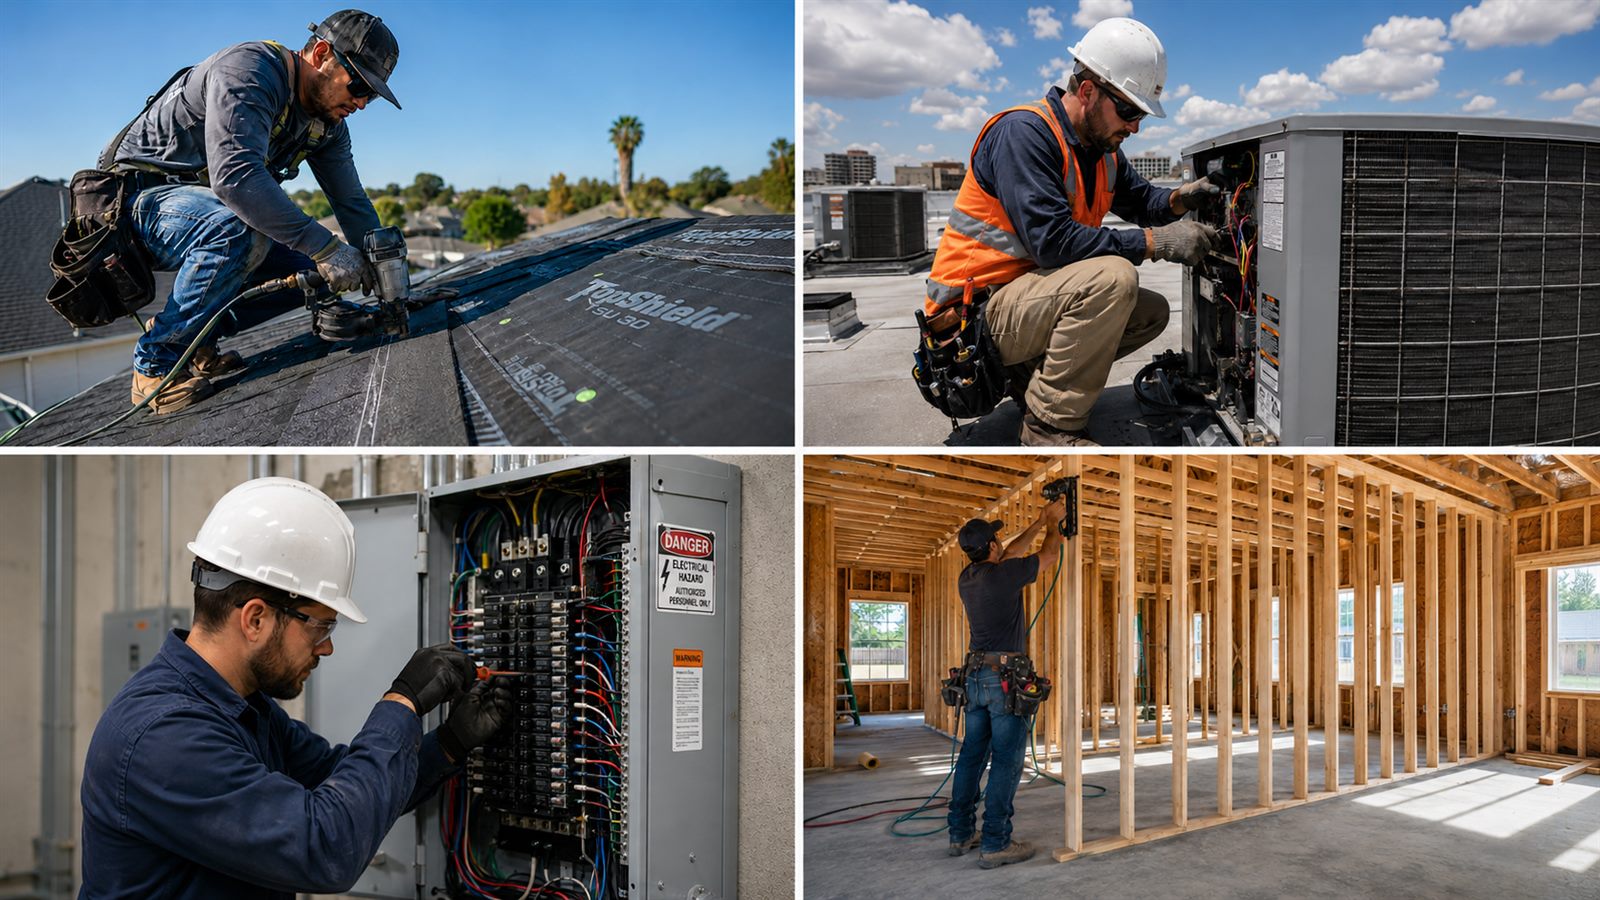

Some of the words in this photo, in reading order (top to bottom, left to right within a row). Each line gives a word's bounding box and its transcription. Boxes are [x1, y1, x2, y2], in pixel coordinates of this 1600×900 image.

[565, 278, 740, 332] TopShield
[665, 534, 709, 554] DANGER
[672, 560, 709, 573] ELECTRICAL
[678, 573, 704, 584] HAZARD
